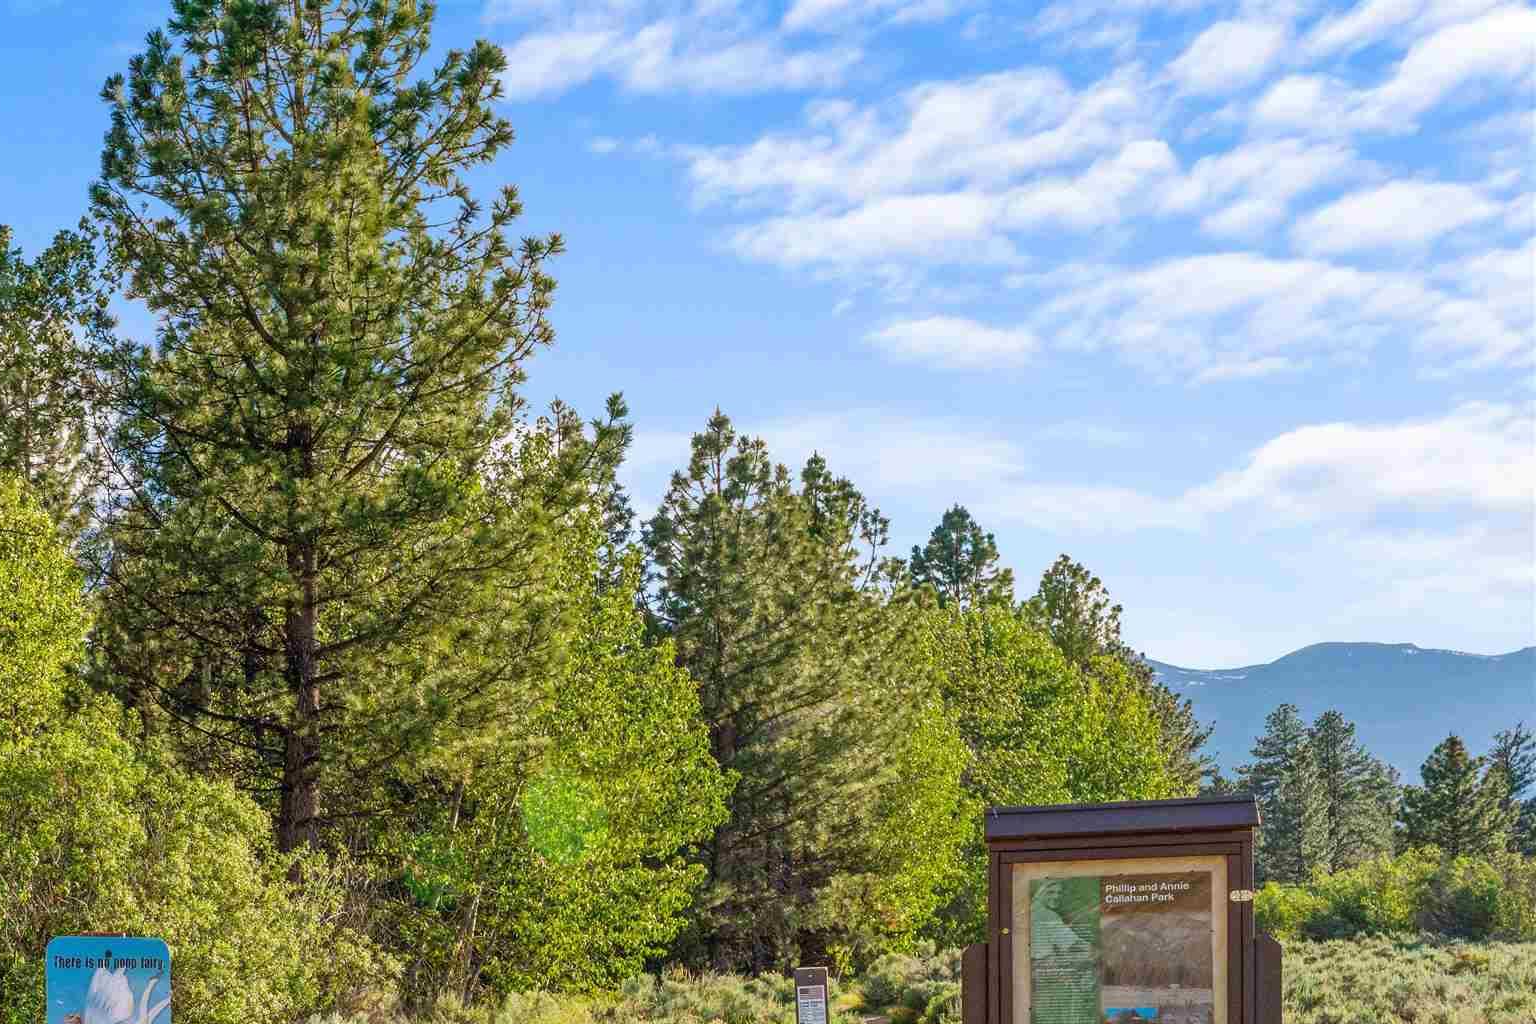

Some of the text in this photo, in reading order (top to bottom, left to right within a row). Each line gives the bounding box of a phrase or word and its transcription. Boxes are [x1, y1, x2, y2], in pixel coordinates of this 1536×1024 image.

[1105, 880, 1190, 894] Phillip and Annie
[1105, 892, 1175, 904] Callahan Park
[54, 955, 82, 969] There
[85, 956, 95, 969] is
[98, 957, 110, 969] no
[113, 957, 137, 970] poop
